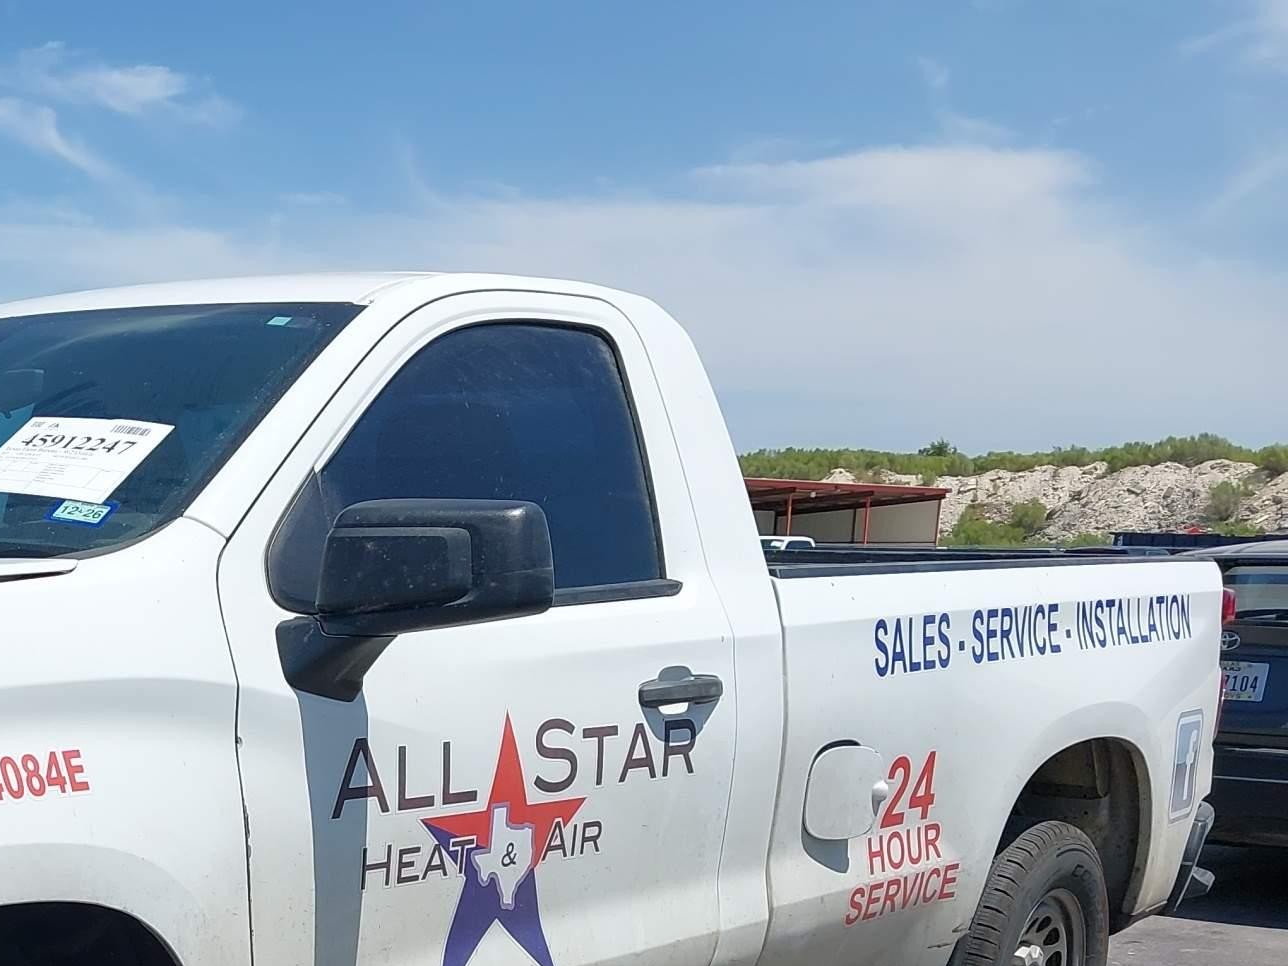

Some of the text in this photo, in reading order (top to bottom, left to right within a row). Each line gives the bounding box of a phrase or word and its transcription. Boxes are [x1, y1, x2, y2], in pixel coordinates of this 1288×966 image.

[21, 432, 137, 455] 45912247
[60, 505, 104, 519] 12 26
[874, 611, 951, 678] SALES
[971, 603, 1062, 664] SERVICE
[1076, 594, 1193, 650] INSTALLATION
[330, 718, 697, 820] ALL STAR
[879, 750, 938, 830] 24
[360, 820, 603, 890] HEAT & AIR
[866, 822, 942, 875] HOUR
[843, 863, 961, 927] SERVICE
